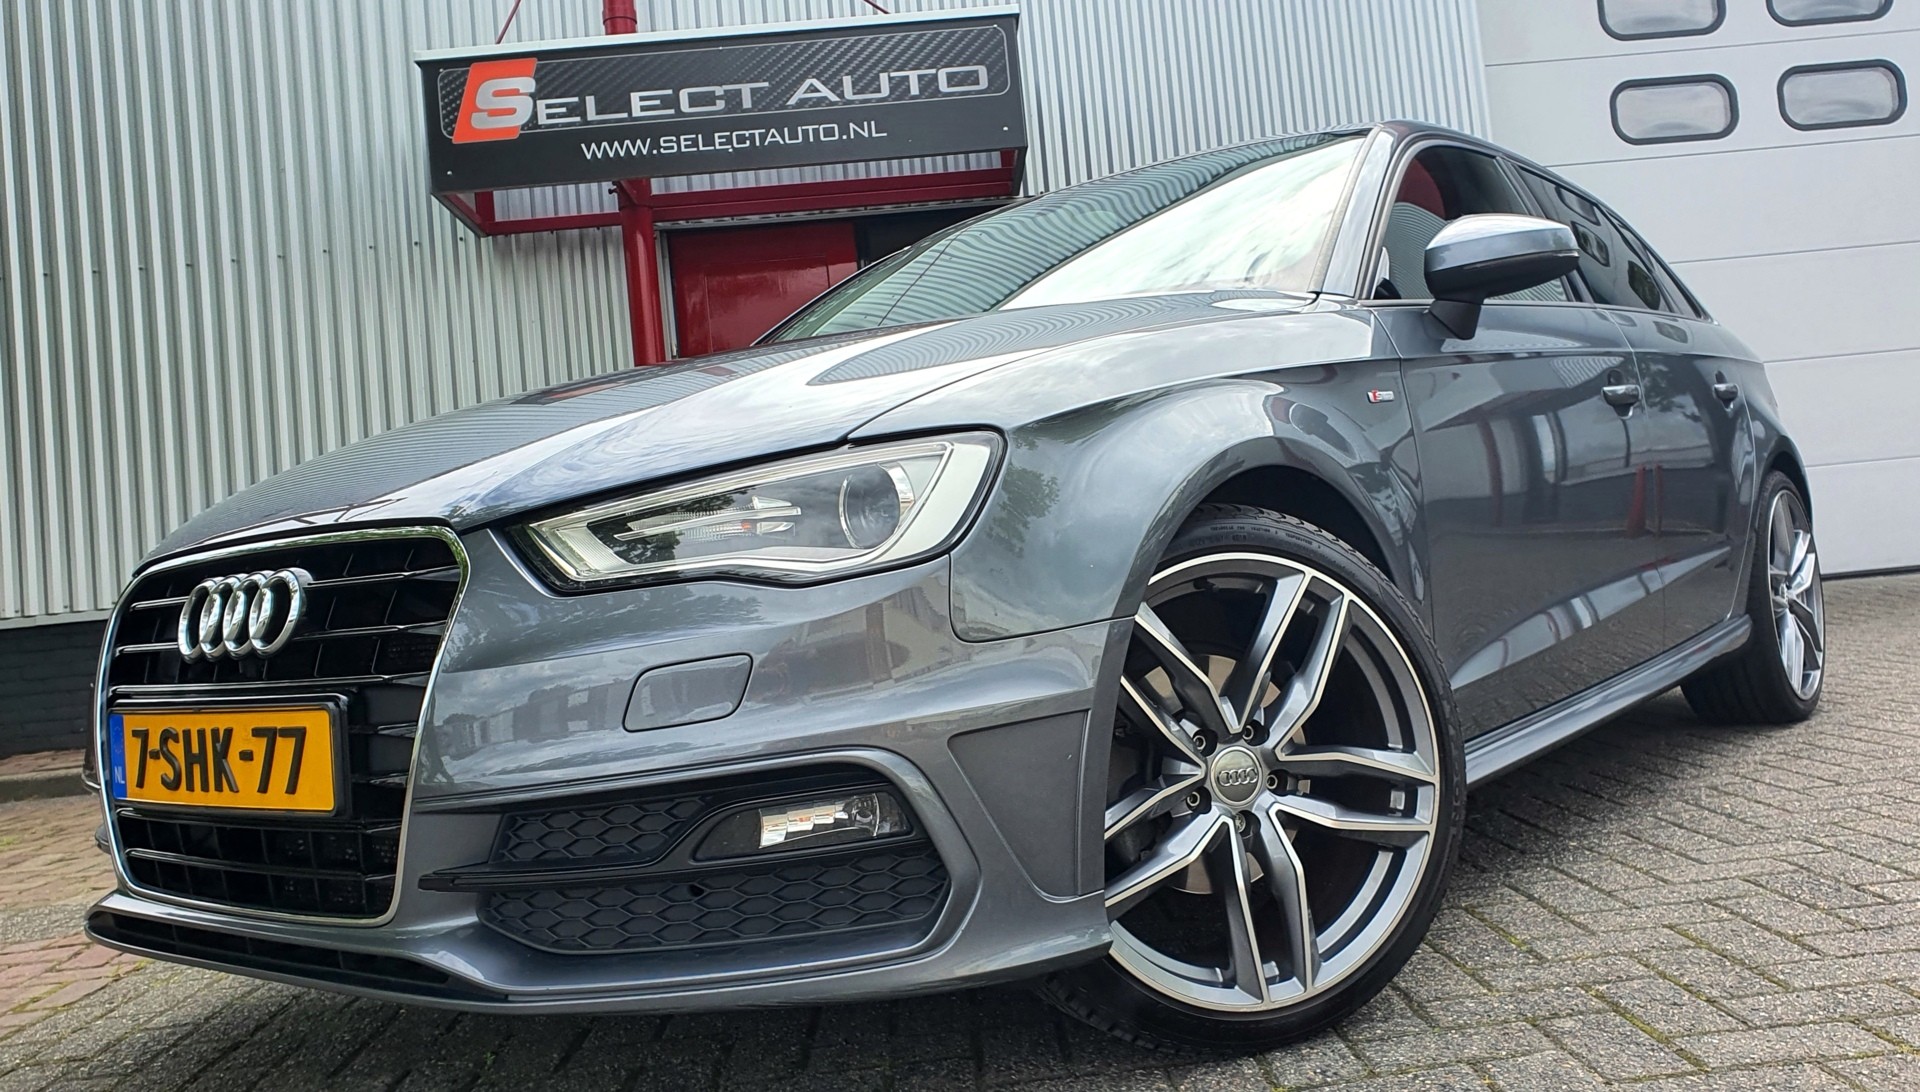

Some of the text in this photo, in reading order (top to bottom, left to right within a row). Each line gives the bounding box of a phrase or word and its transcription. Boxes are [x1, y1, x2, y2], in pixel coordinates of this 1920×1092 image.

[471, 65, 989, 130] SELECT AUTO
[581, 121, 888, 160] WWW.SELECTAUTO.NL
[114, 766, 126, 784] NL
[131, 726, 306, 795] 7-SHK-77
